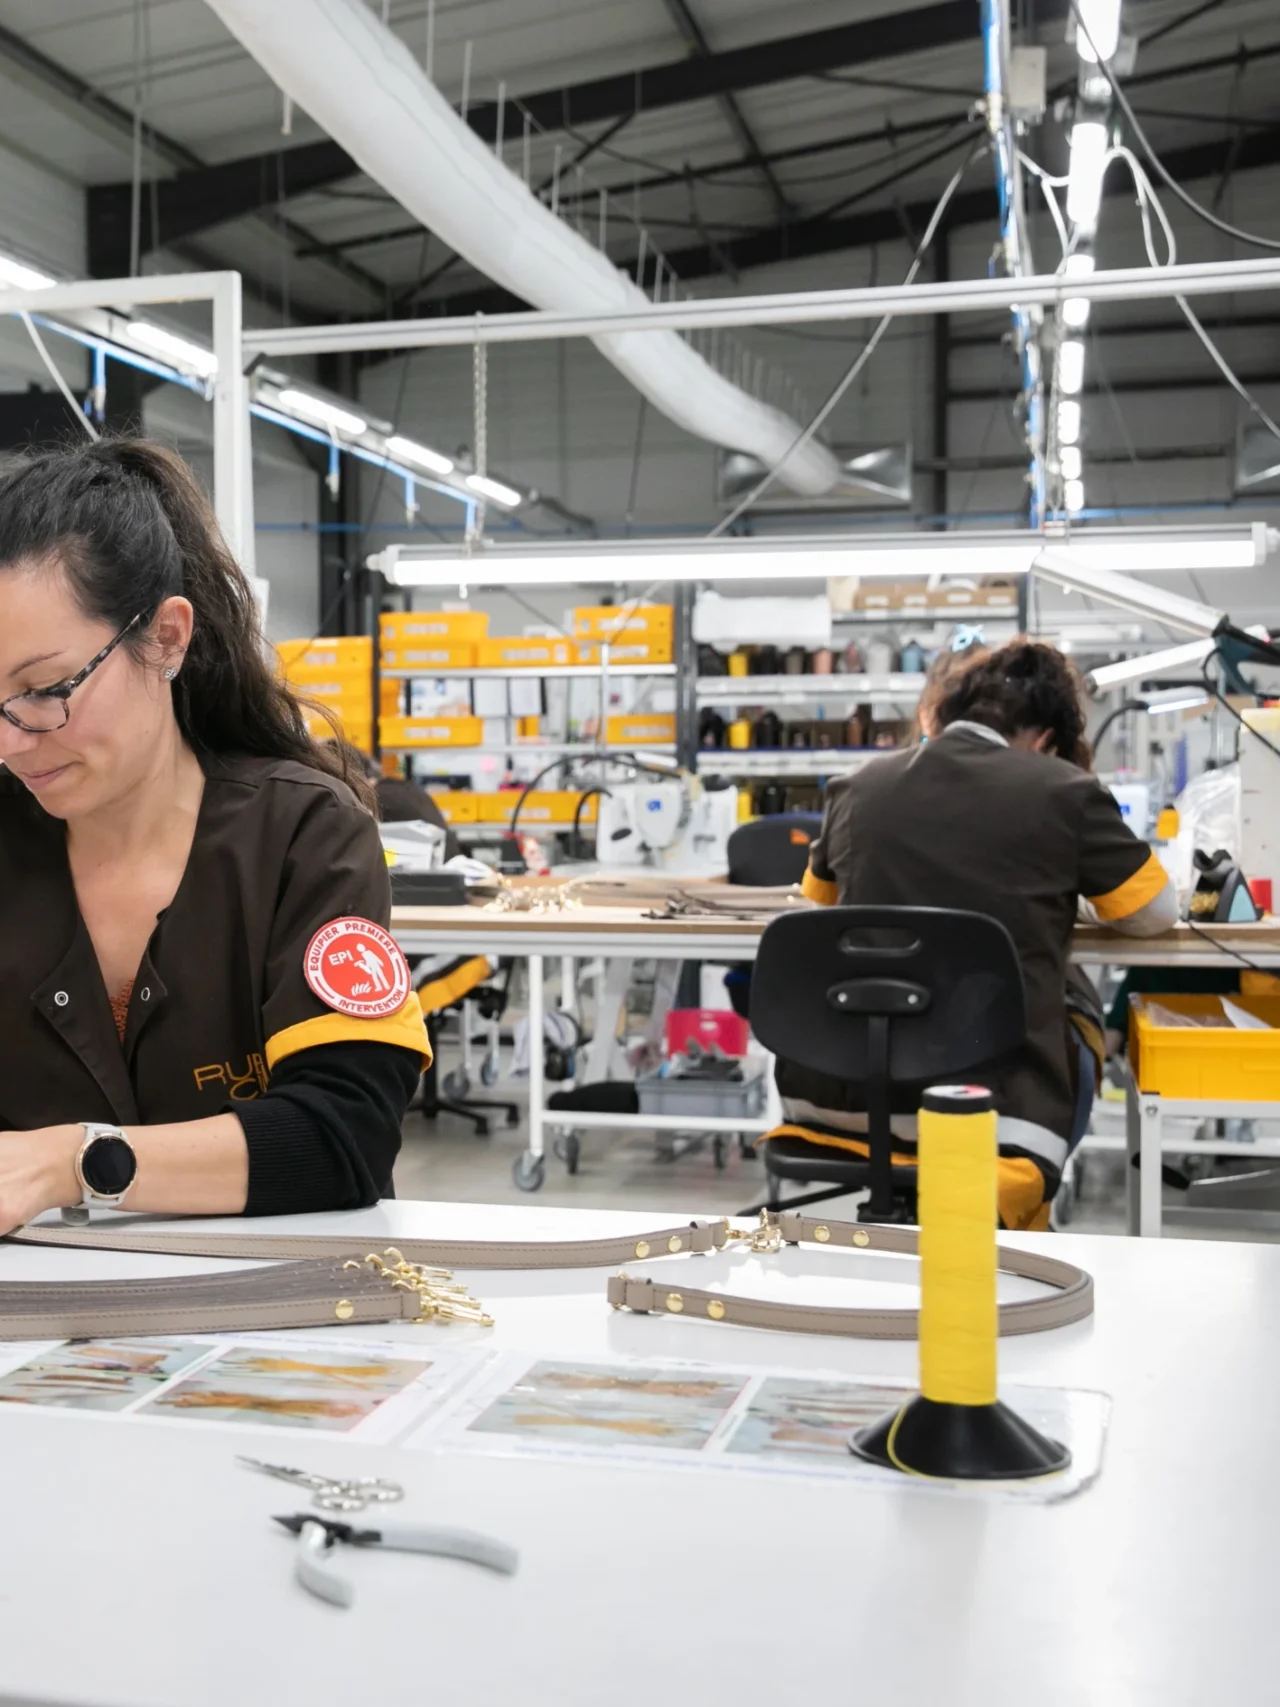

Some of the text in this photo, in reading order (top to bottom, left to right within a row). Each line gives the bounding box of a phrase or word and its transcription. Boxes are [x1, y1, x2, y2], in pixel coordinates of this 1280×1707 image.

[310, 922, 396, 971] EQUIPIER PREMIERE
[328, 950, 354, 966] EPI
[338, 988, 404, 1013] INTERVENTION
